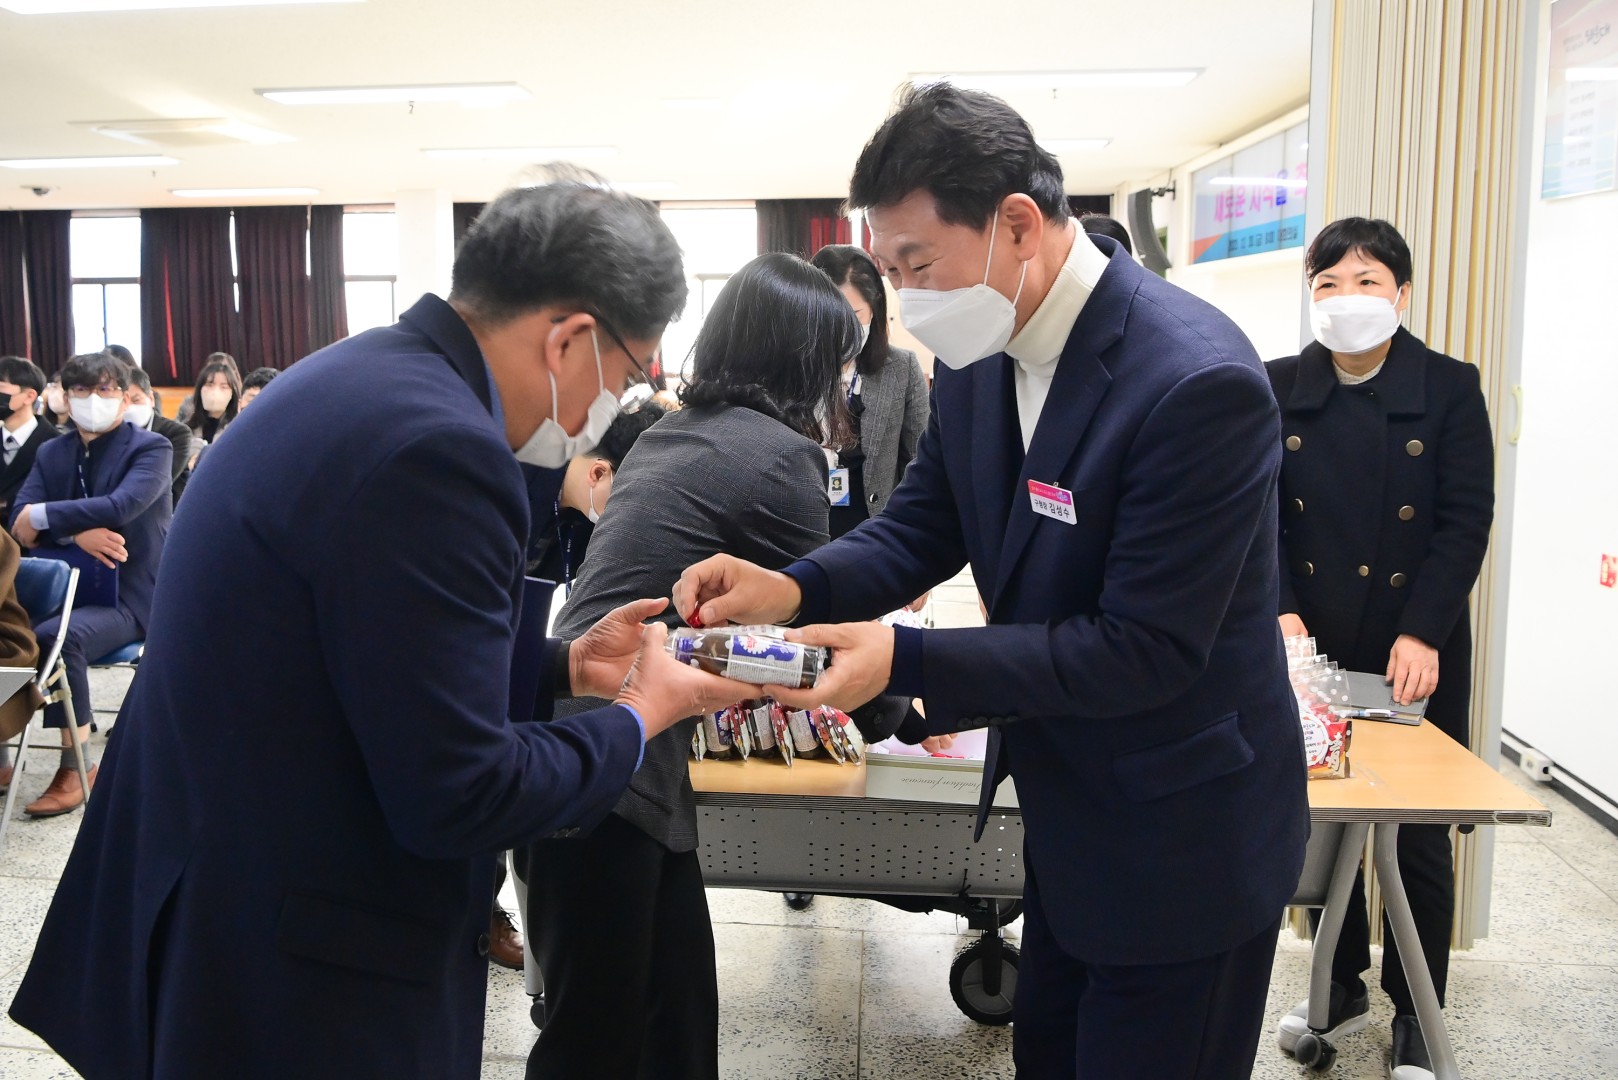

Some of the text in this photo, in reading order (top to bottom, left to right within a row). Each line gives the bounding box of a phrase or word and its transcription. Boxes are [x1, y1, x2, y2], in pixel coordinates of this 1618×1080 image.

[1035, 499, 1070, 518] 구청장 김성수
[899, 776, 982, 794] Tradition française
